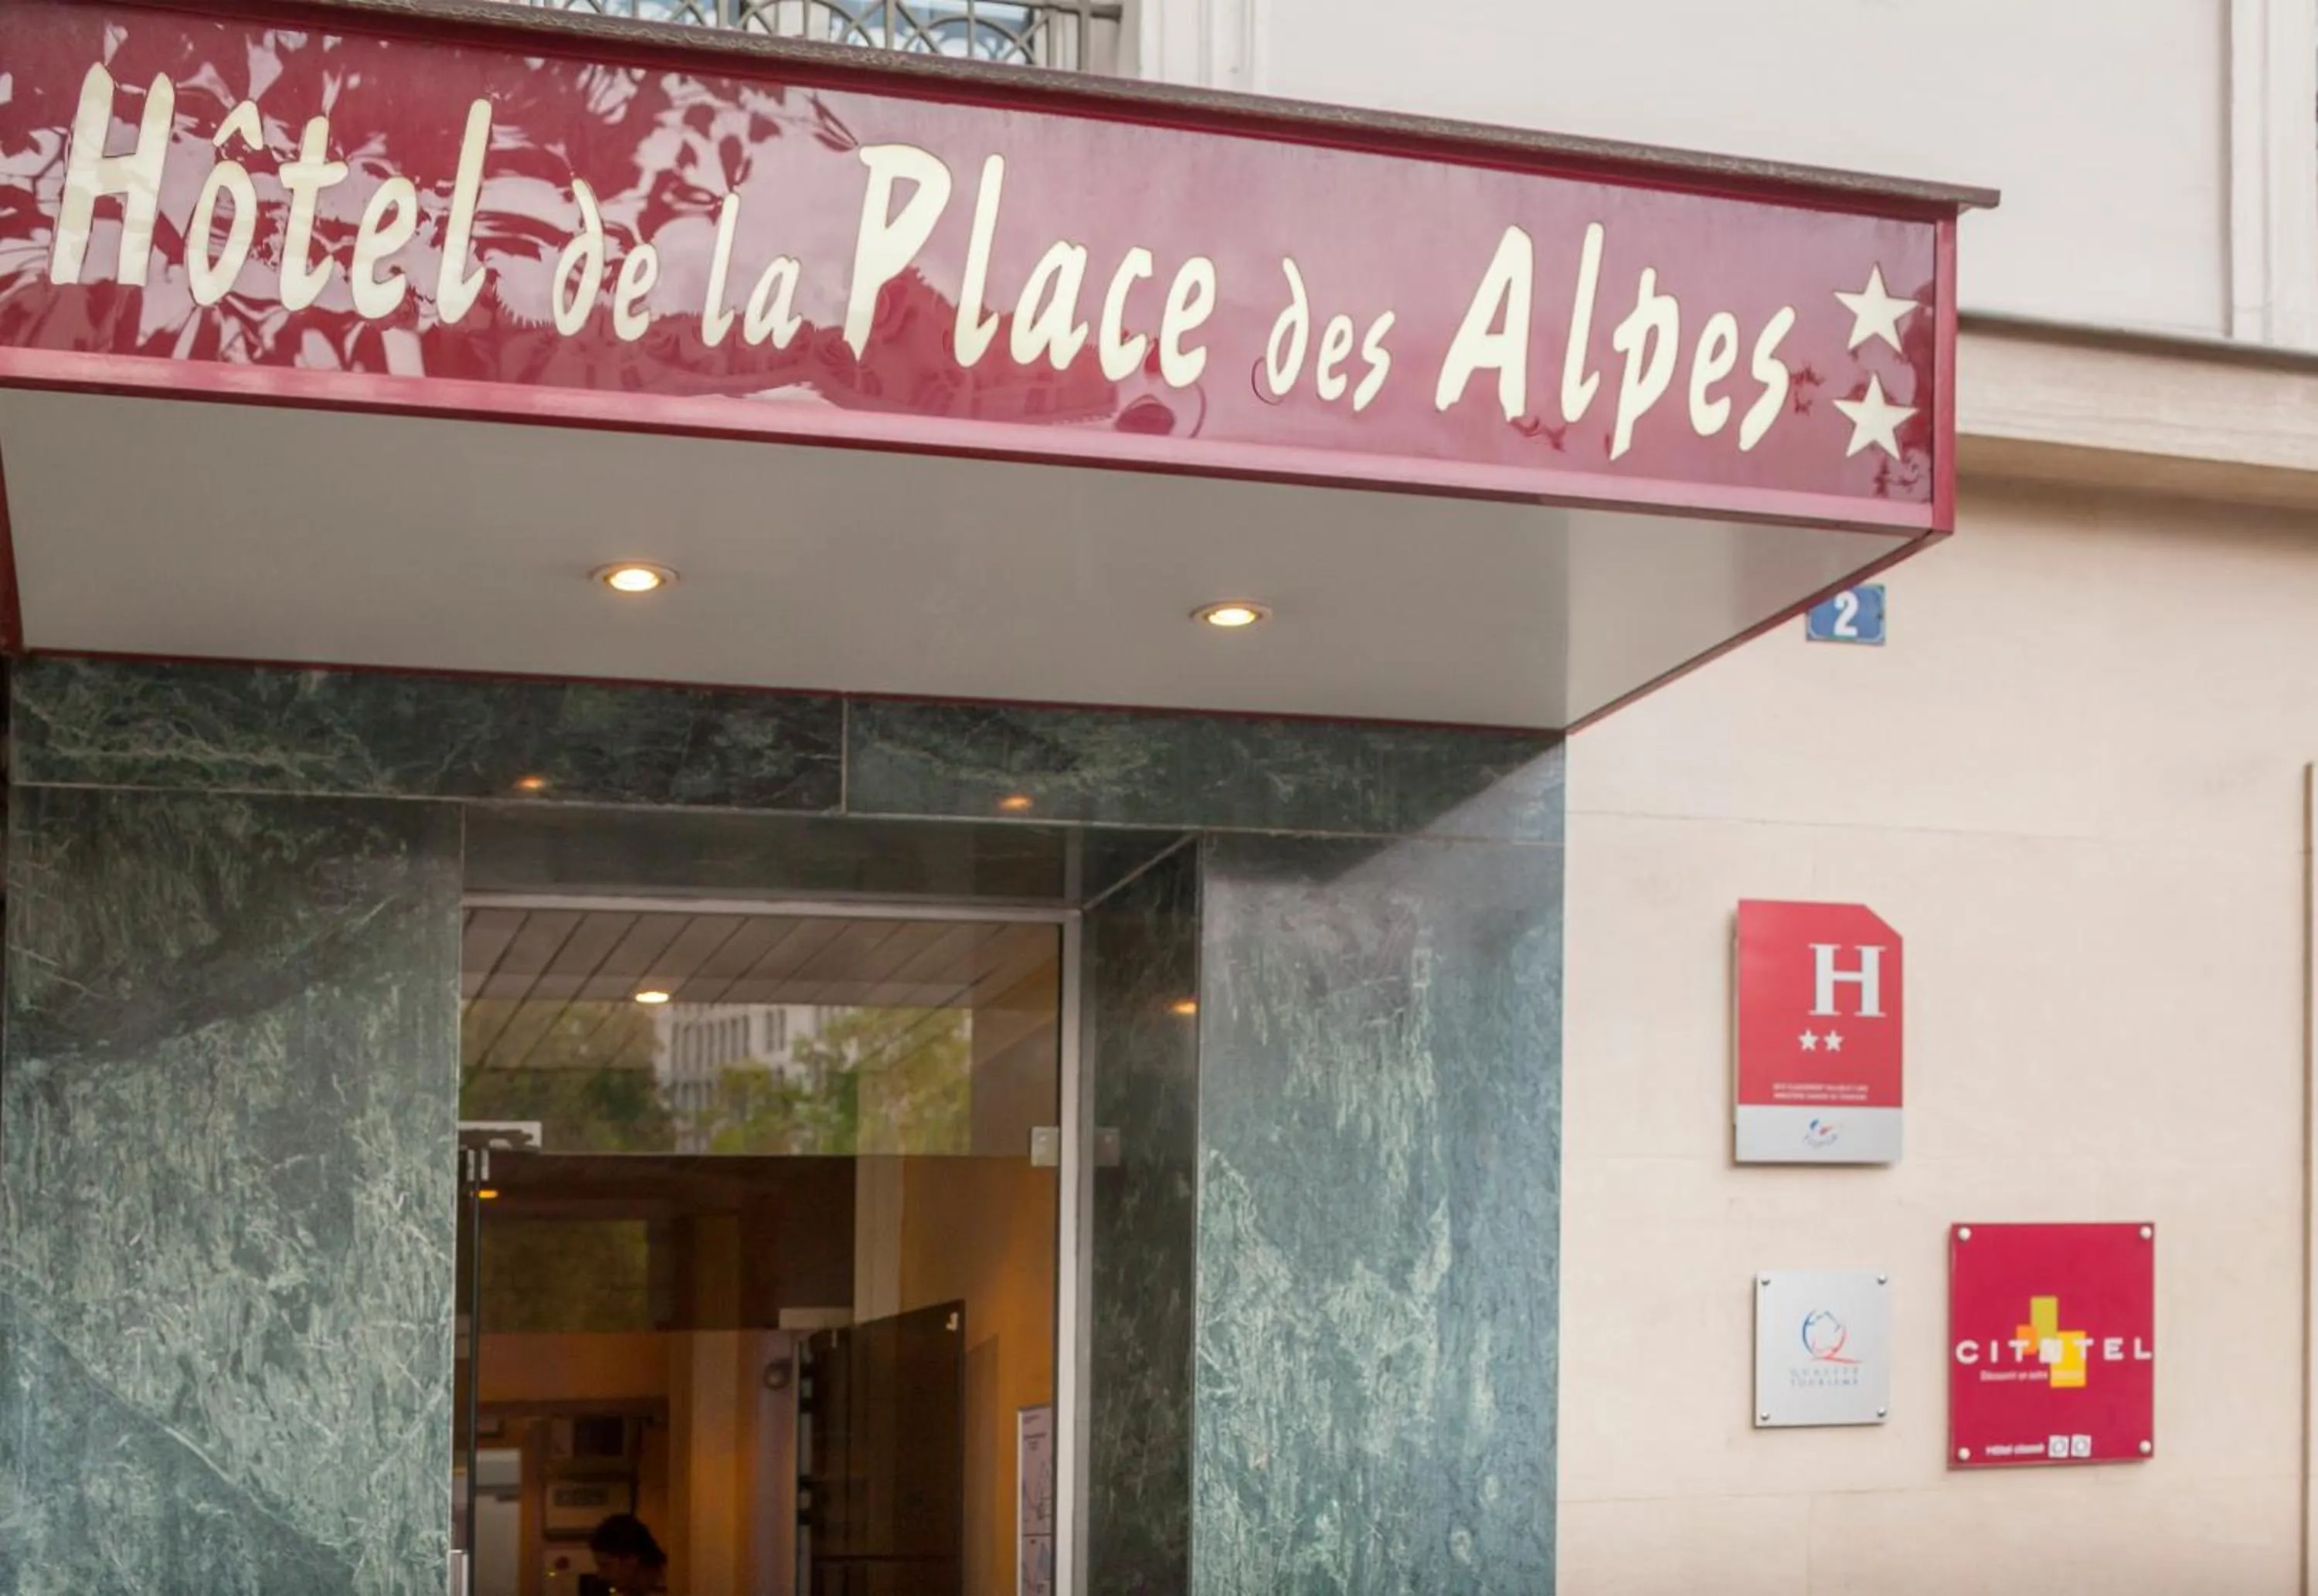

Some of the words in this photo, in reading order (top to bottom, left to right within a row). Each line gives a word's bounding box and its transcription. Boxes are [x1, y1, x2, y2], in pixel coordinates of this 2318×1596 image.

[50, 62, 492, 324] Hôtel
[552, 178, 658, 341] de
[702, 193, 802, 349] la
[843, 144, 1215, 388] Place
[1266, 257, 1395, 411] des
[1435, 222, 1795, 460] Alpes
[1834, 590, 1858, 637] 2
[1808, 942, 1888, 1017] H
